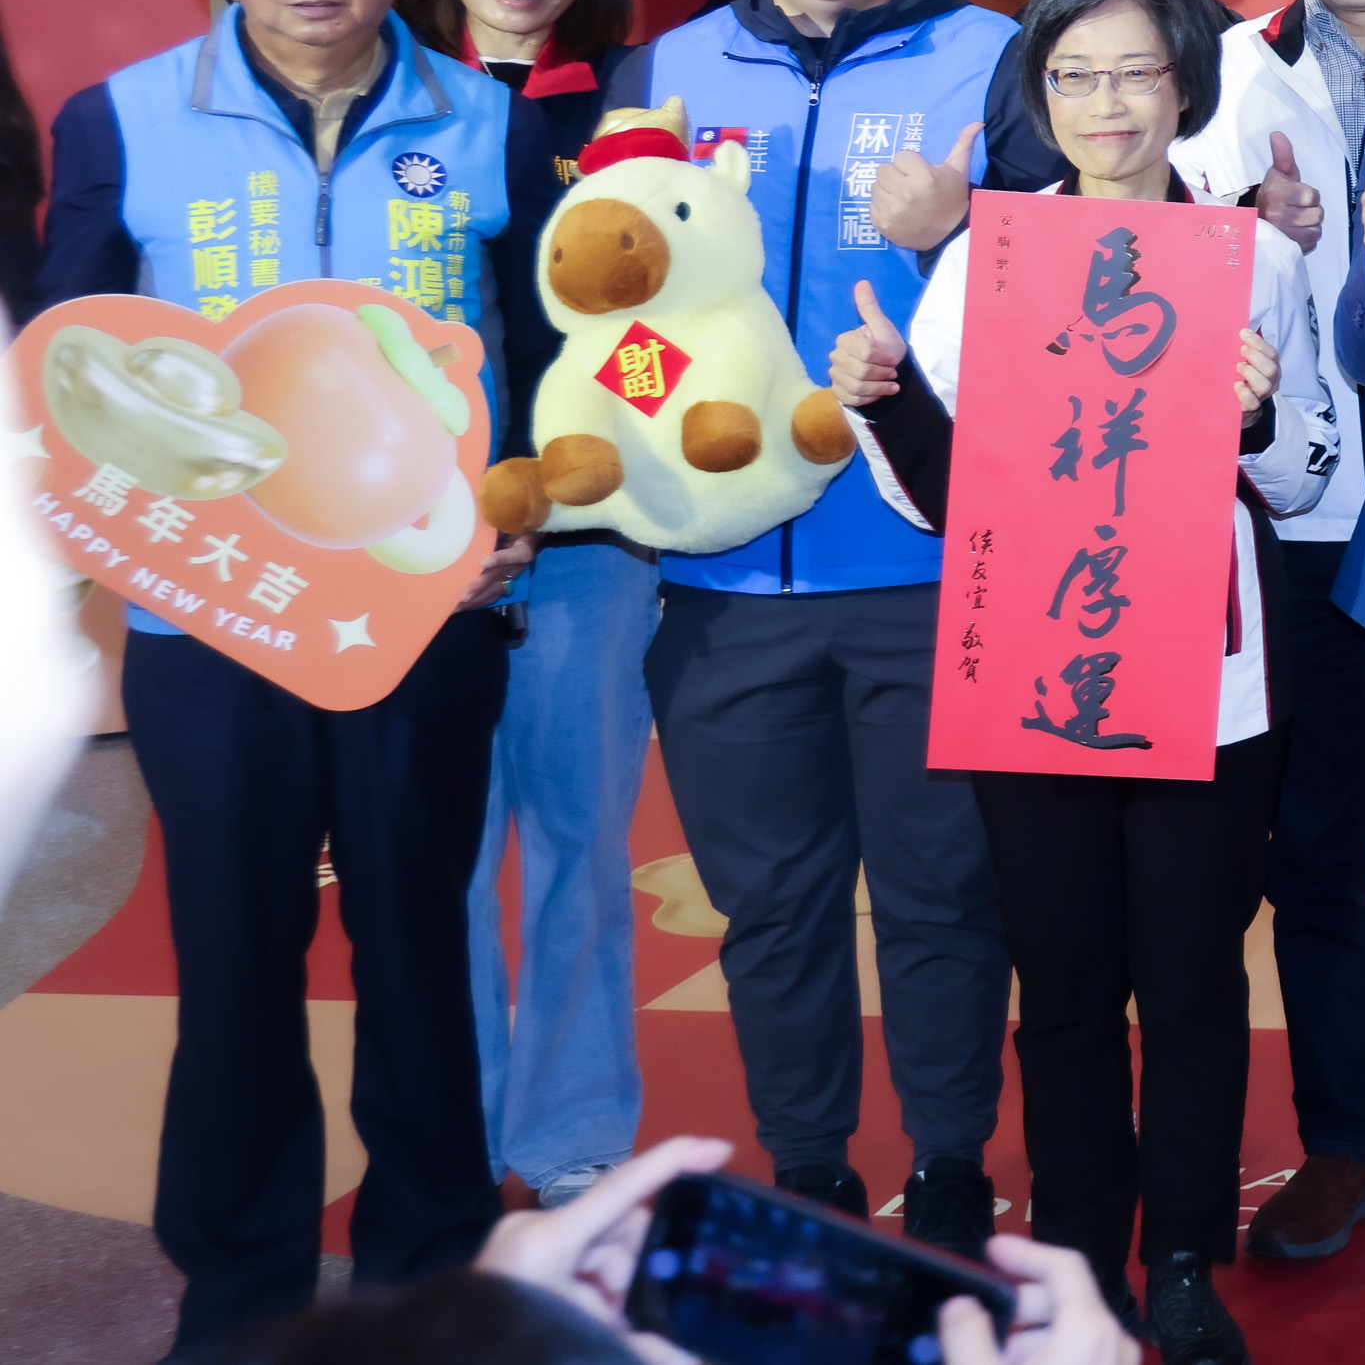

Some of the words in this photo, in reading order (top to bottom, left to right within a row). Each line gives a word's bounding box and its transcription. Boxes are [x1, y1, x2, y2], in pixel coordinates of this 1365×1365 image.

[247, 169, 281, 287] 機要秘書
[842, 118, 893, 245] 林德福
[387, 198, 445, 312] 陳鴻
[31, 491, 131, 568] HAPPY
[129, 566, 207, 614] NEW
[213, 607, 298, 652] YEAR
[72, 461, 311, 615] 馬年大吉
